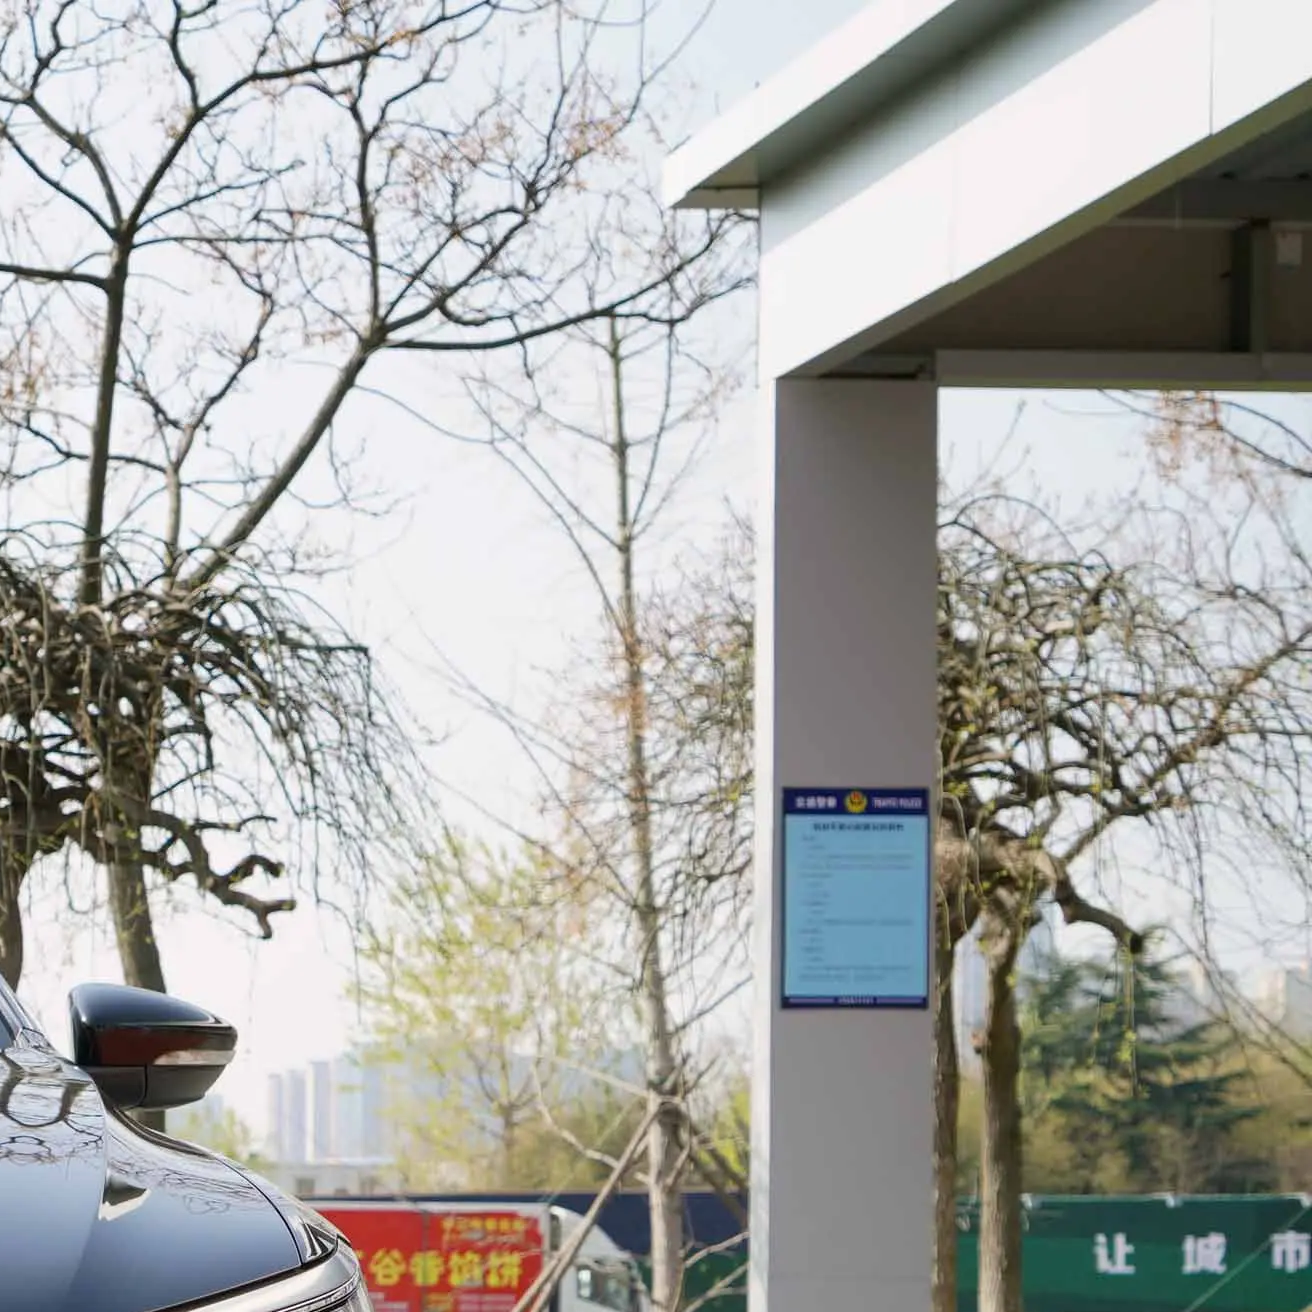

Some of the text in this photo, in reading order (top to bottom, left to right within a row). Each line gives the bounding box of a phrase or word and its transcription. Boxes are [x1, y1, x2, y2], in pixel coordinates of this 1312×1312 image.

[356, 1249, 521, 1287] 谷香馅饼
[1093, 1230, 1311, 1274] 让城市
